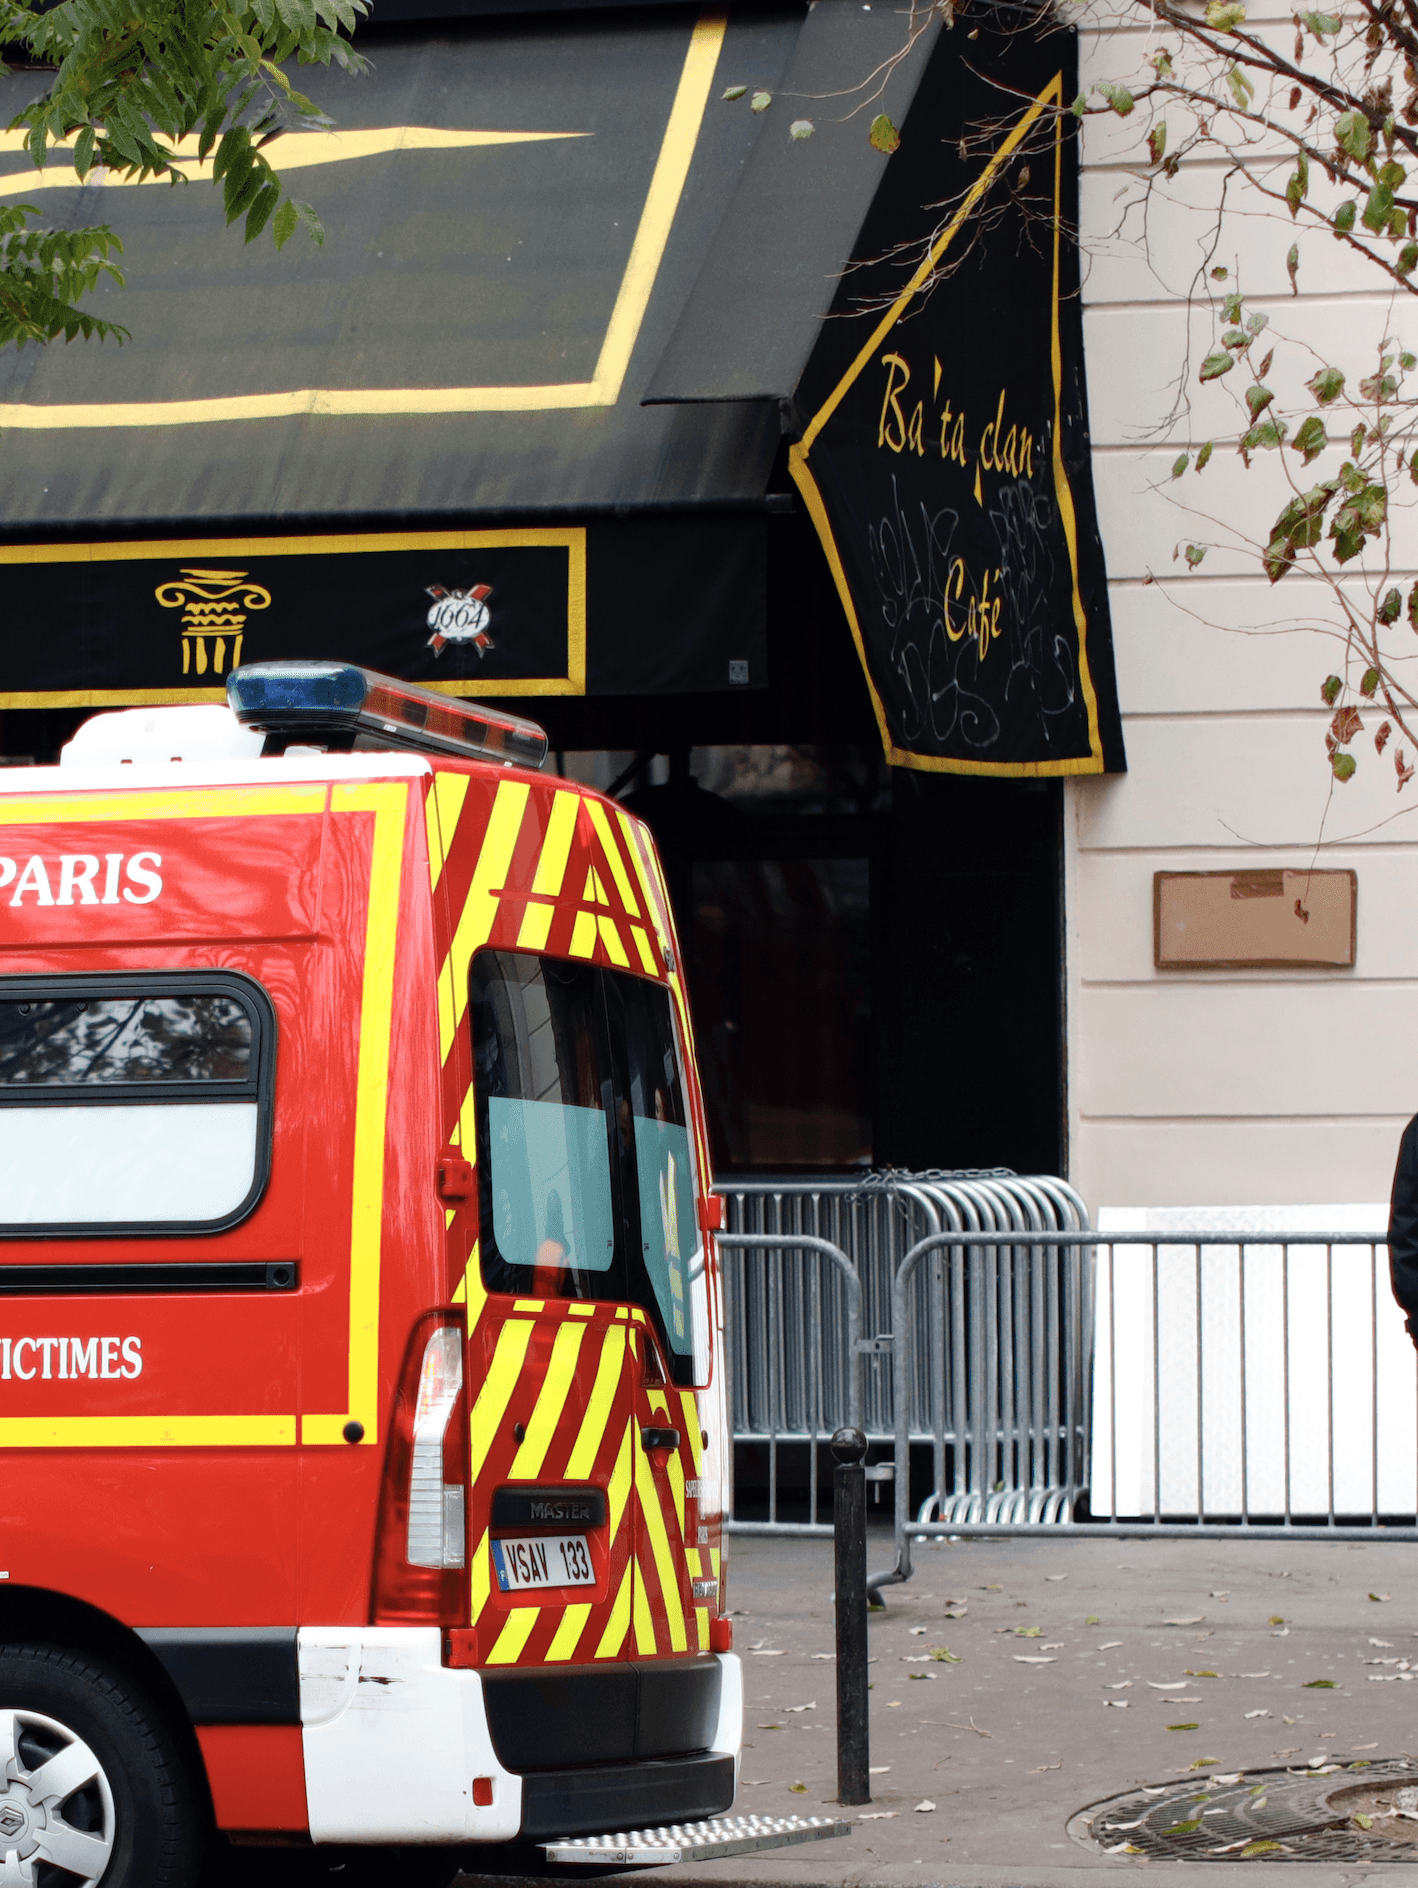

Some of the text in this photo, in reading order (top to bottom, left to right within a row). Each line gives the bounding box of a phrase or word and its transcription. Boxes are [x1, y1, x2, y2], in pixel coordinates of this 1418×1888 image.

[430, 602, 486, 630] 1664
[943, 557, 1003, 663] Café
[0, 1335, 143, 1381] ICTIMES
[530, 1501, 590, 1520] MASTER
[505, 1540, 590, 1584] VSAV 133
